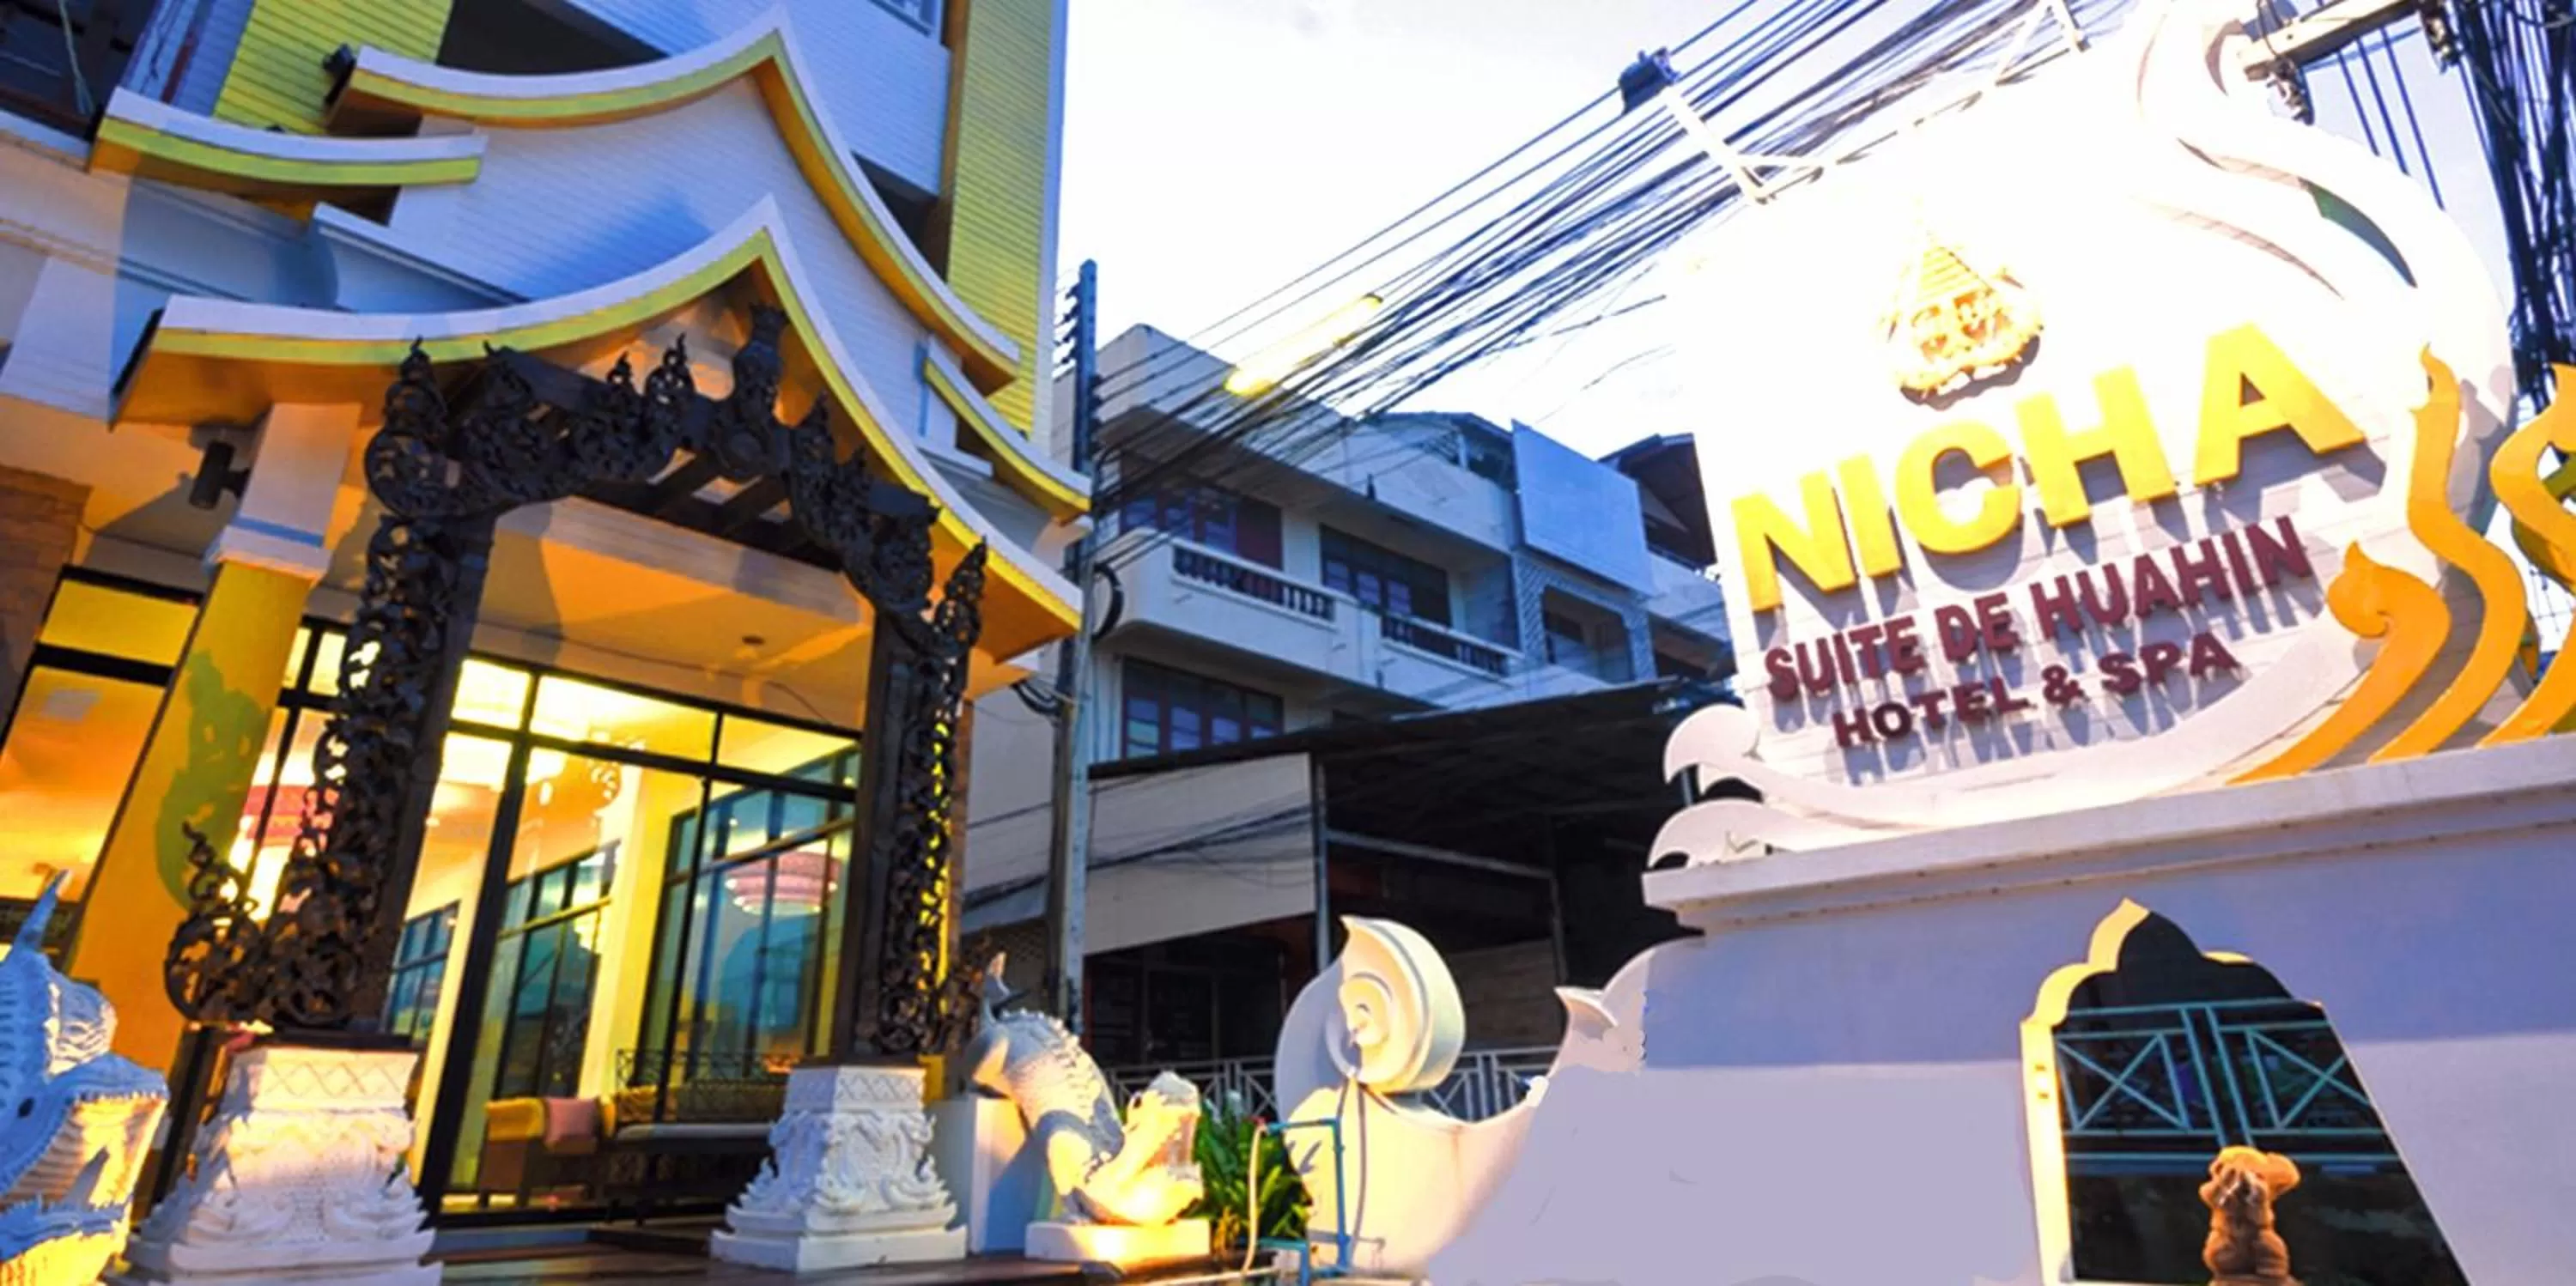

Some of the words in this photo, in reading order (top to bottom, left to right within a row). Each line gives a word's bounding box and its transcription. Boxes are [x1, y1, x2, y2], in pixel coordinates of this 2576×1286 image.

[1731, 323, 2366, 613] NICHA
[1765, 616, 1926, 702] SUITE
[1934, 592, 2020, 661] DE
[2029, 516, 2313, 640] HUAHIN
[1832, 676, 2033, 749] HOTEL
[2041, 664, 2088, 706] &
[2099, 631, 2240, 695] SPA
